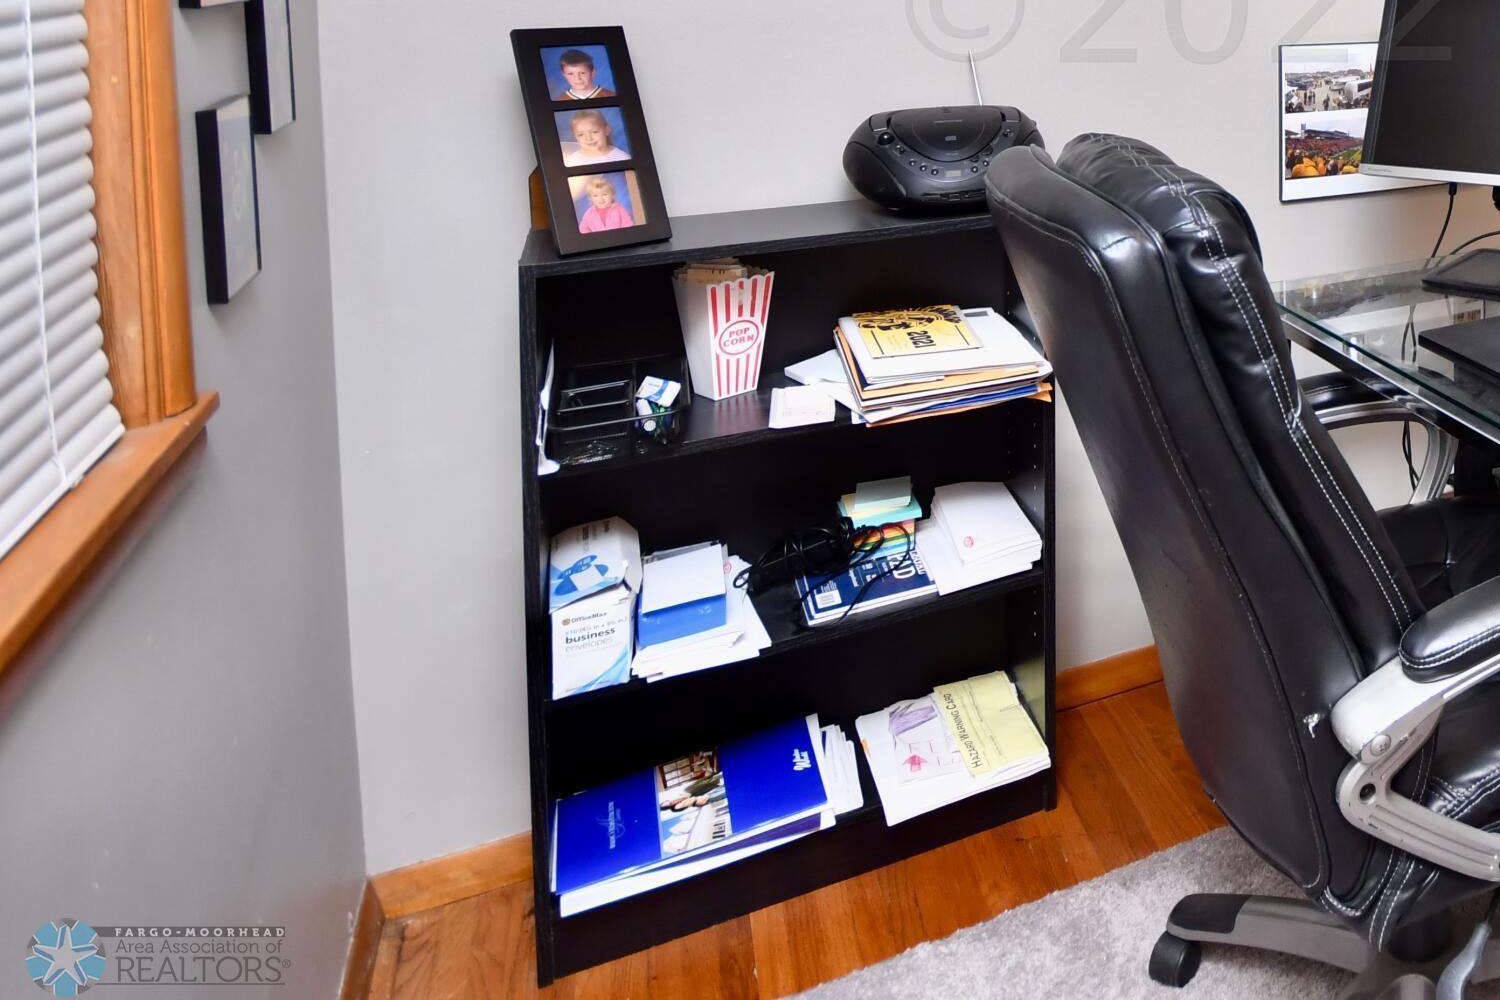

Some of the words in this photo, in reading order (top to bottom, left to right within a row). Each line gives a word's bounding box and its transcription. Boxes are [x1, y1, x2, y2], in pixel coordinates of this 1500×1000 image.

[728, 327, 750, 338] POP
[907, 330, 937, 348] 2021
[723, 335, 754, 348] CORN
[570, 612, 608, 623] OfficeMax
[565, 628, 616, 644] business
[565, 637, 614, 653] envelopes
[944, 693, 957, 710] CARD
[951, 711, 969, 742] WARNING
[965, 740, 983, 769] HAZARD
